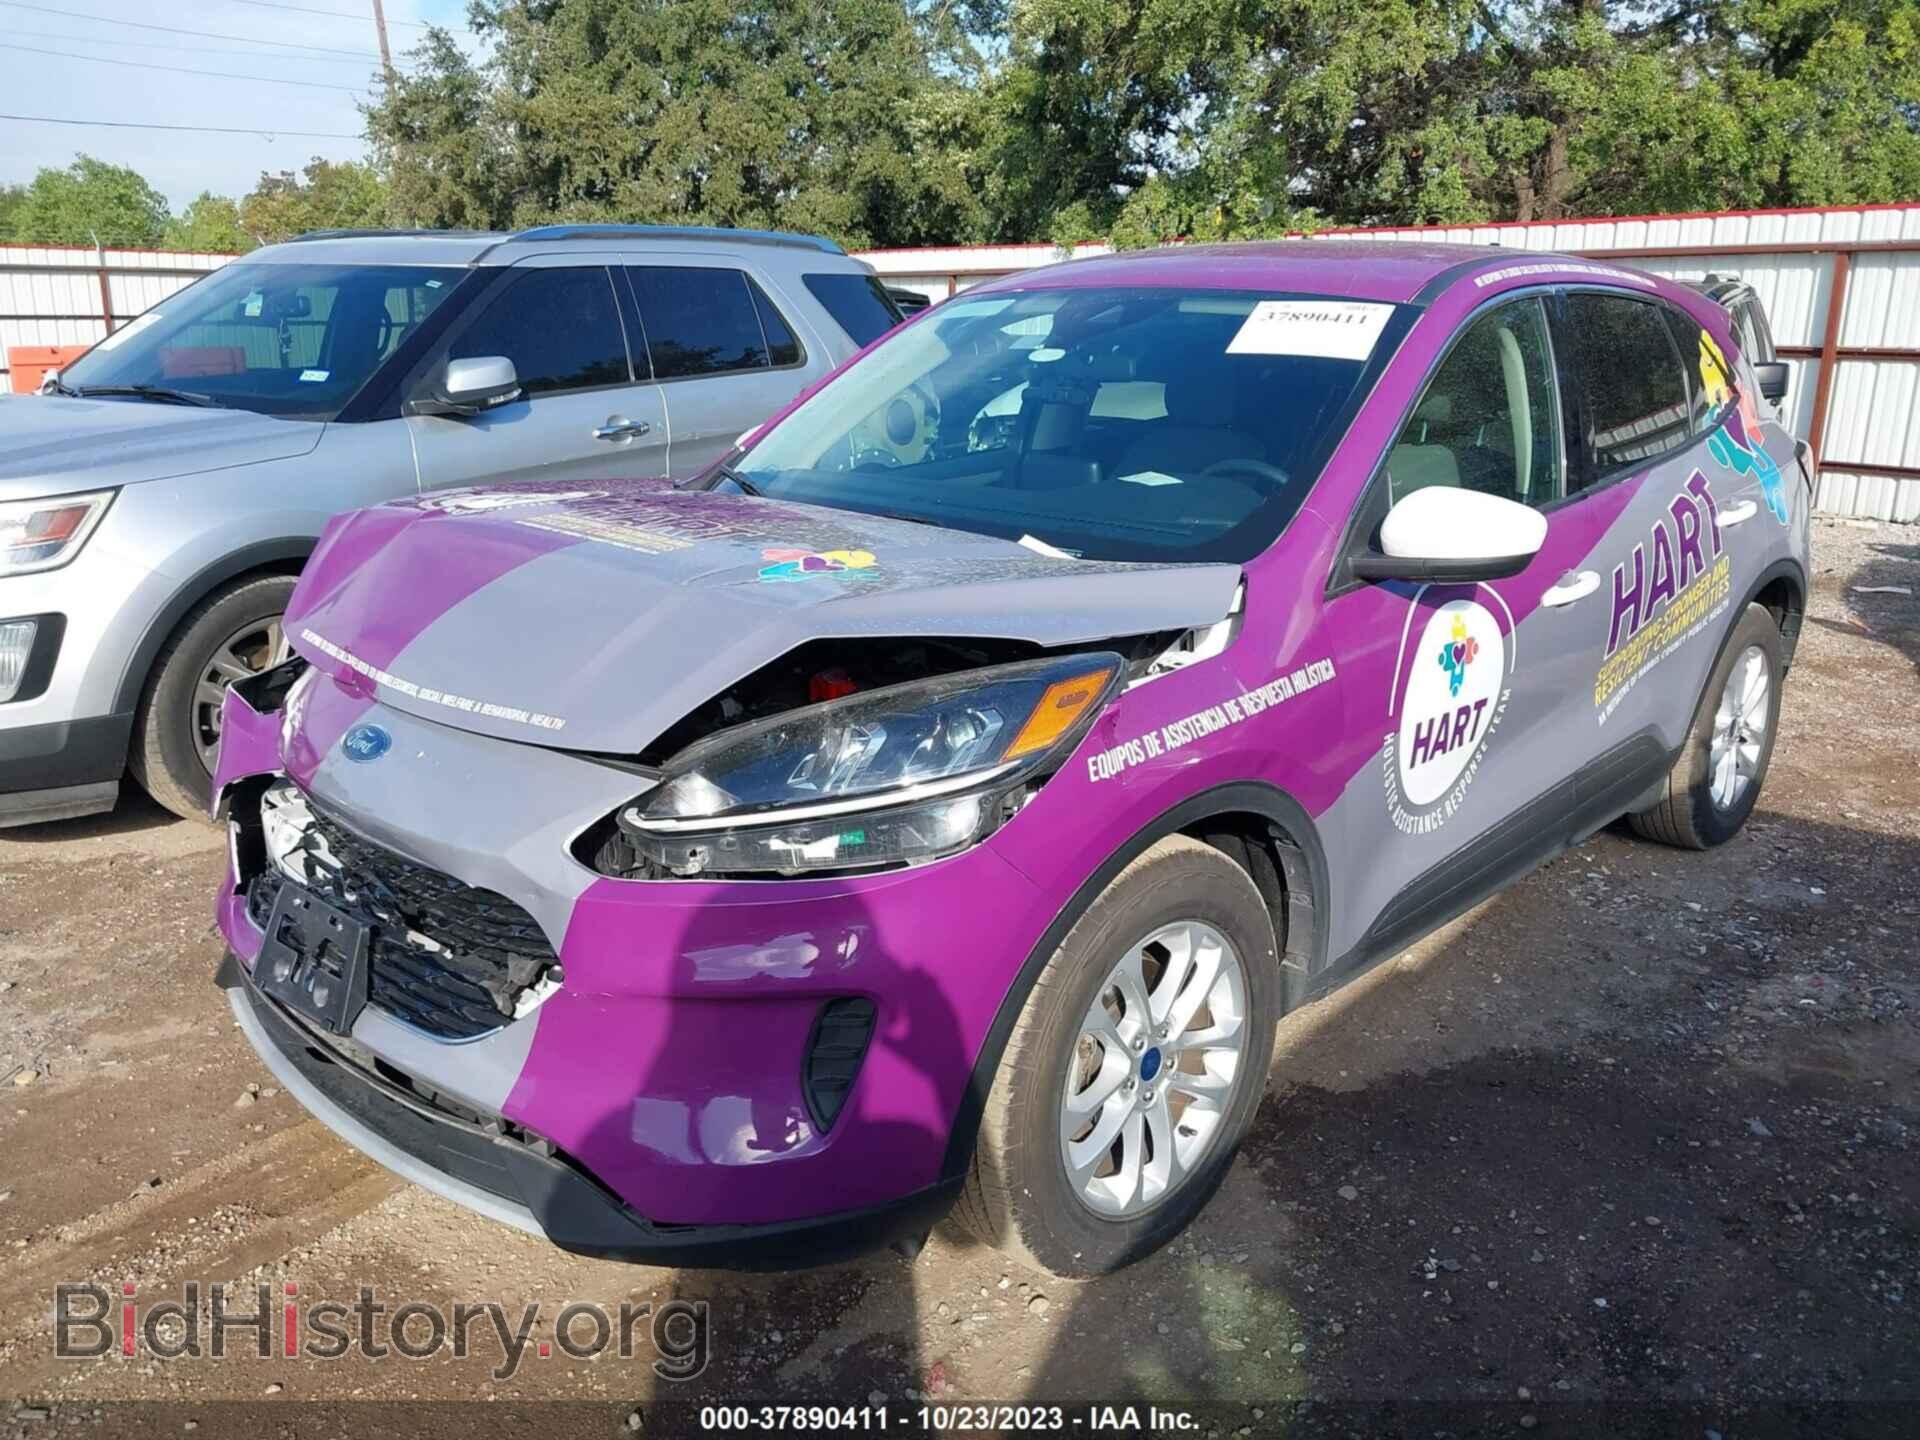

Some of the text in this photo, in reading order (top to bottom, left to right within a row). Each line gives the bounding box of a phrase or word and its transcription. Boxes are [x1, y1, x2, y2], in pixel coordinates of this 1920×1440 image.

[1260, 311, 1368, 324] 37890411
[1604, 467, 1723, 660] HART
[1711, 555, 1730, 586] AND
[1654, 574, 1730, 651] COMMUNITIES
[347, 729, 378, 753] Ford
[528, 712, 567, 731] HEALTH
[1087, 657, 1337, 783] EQUIPOS DE ASISTENCIA DE RESPUESTA HOLÍSTICA
[1409, 697, 1489, 769] HART
[1383, 687, 1512, 835] HOLISTIC ASSISTANCE RESPONSE TEAM
